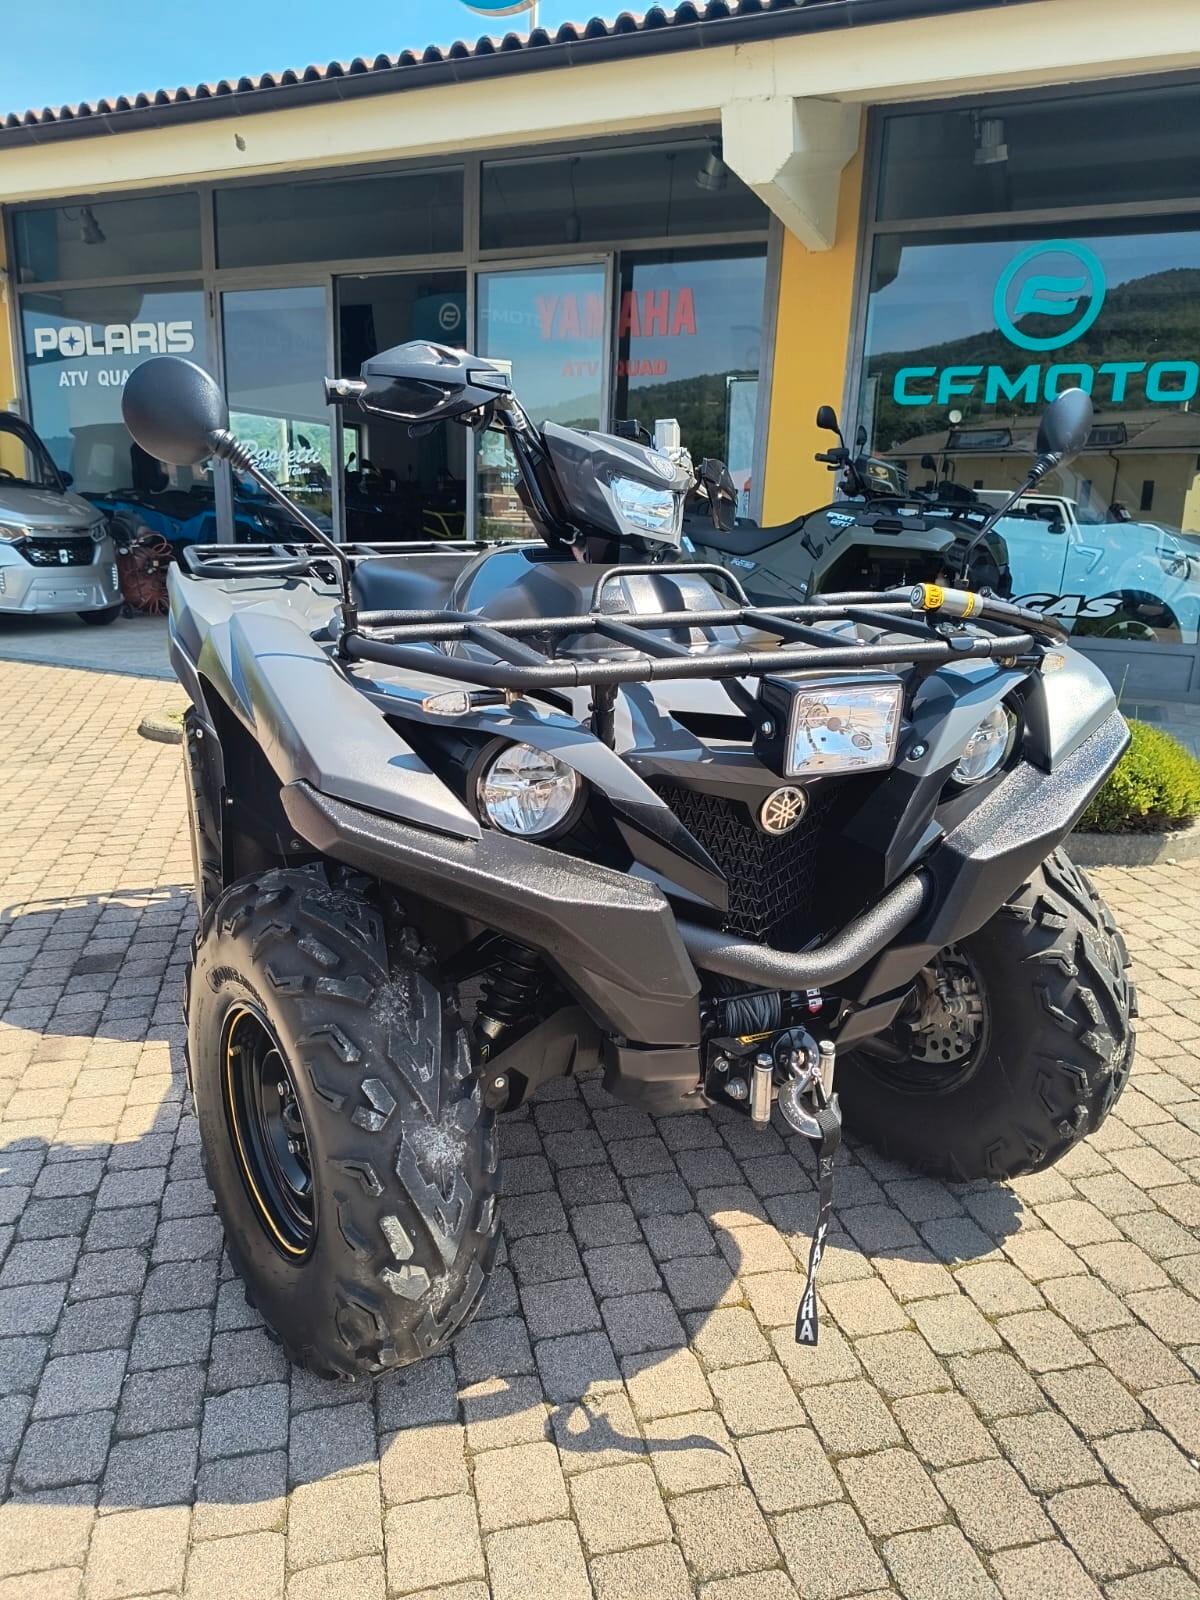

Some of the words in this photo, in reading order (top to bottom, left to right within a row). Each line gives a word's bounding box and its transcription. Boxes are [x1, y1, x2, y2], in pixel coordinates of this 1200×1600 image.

[537, 287, 698, 340] YAMAHA
[34, 321, 194, 358] POLARIS
[58, 370, 88, 387] ATV
[98, 369, 131, 387] QUA
[562, 360, 599, 377] ATV
[615, 359, 668, 377] QUAD
[893, 361, 1199, 405] CFMOTO
